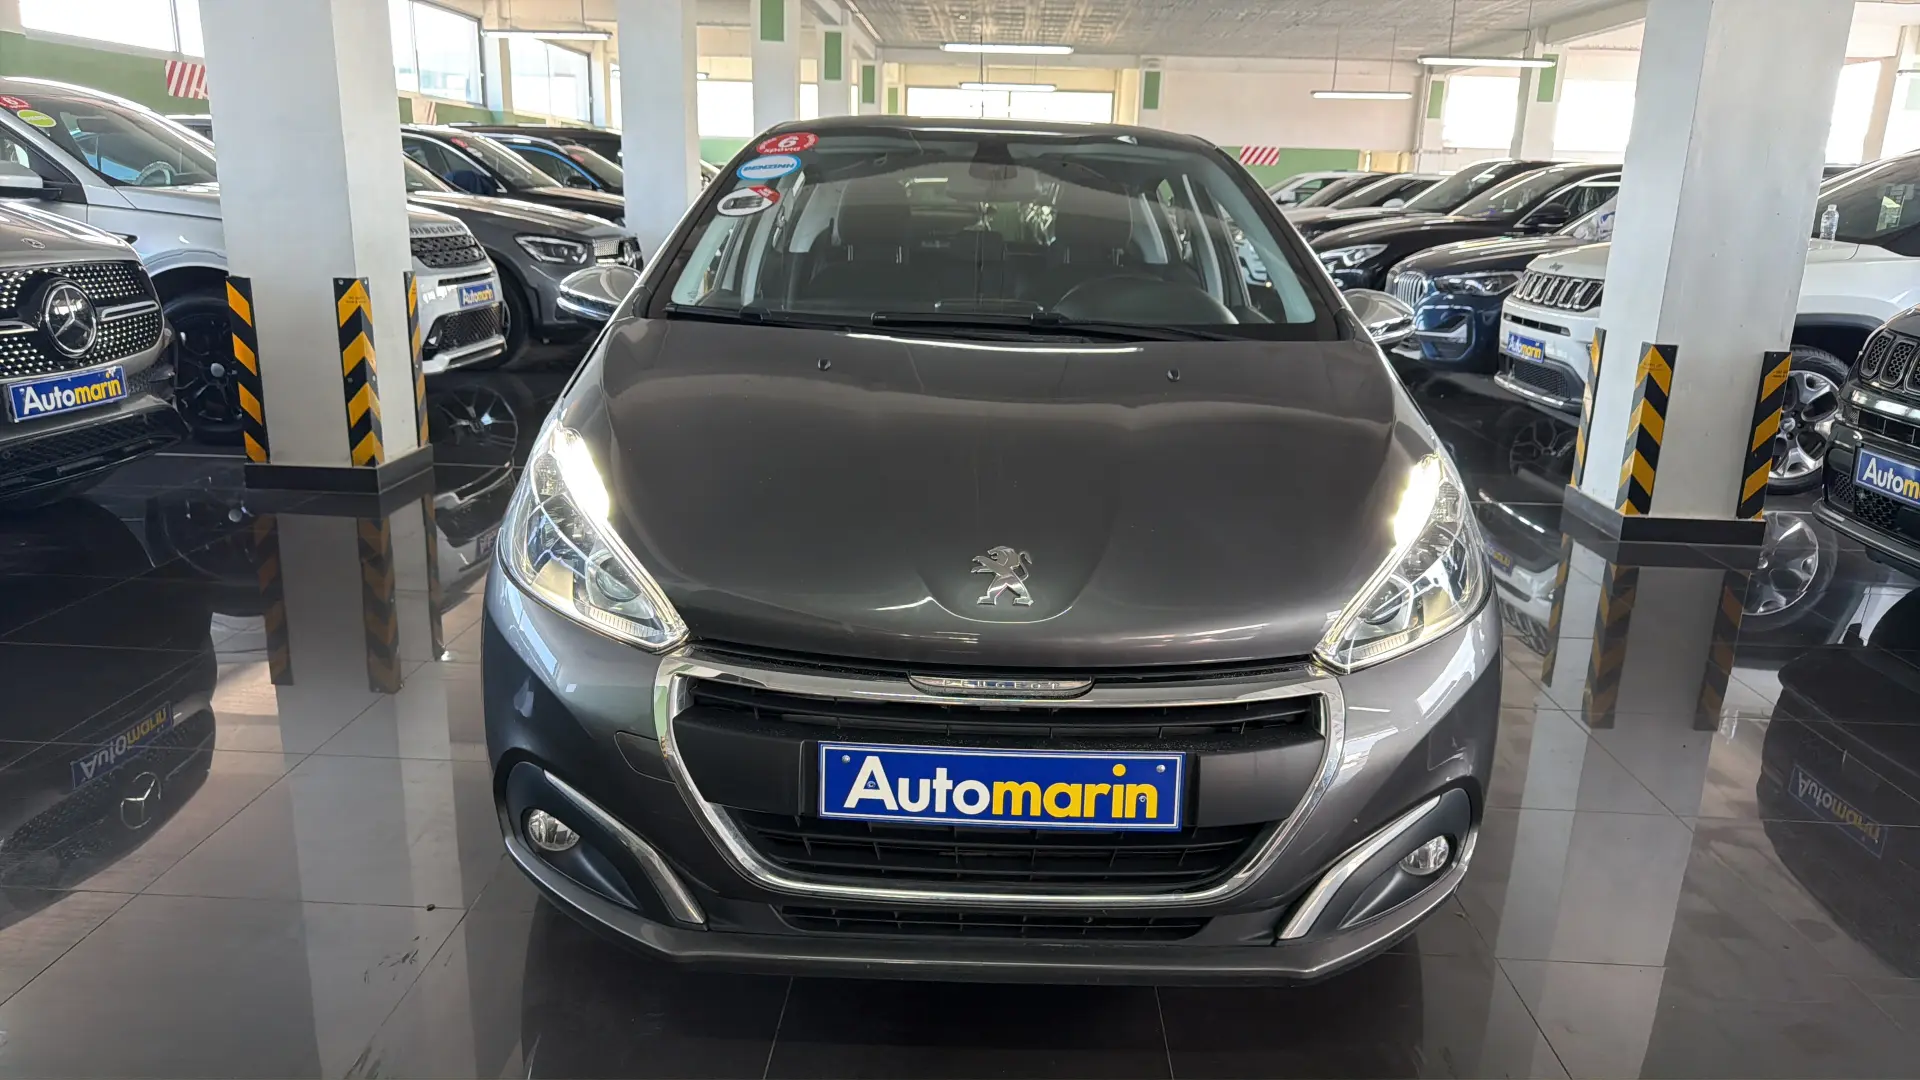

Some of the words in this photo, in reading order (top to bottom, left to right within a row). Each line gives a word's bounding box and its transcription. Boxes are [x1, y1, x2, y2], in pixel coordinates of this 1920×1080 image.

[777, 135, 800, 148] 6
[23, 372, 122, 415] Automarin
[1862, 457, 1920, 500] Autom
[942, 679, 1060, 690] PEUGEOT
[843, 756, 1159, 819] Automarin
